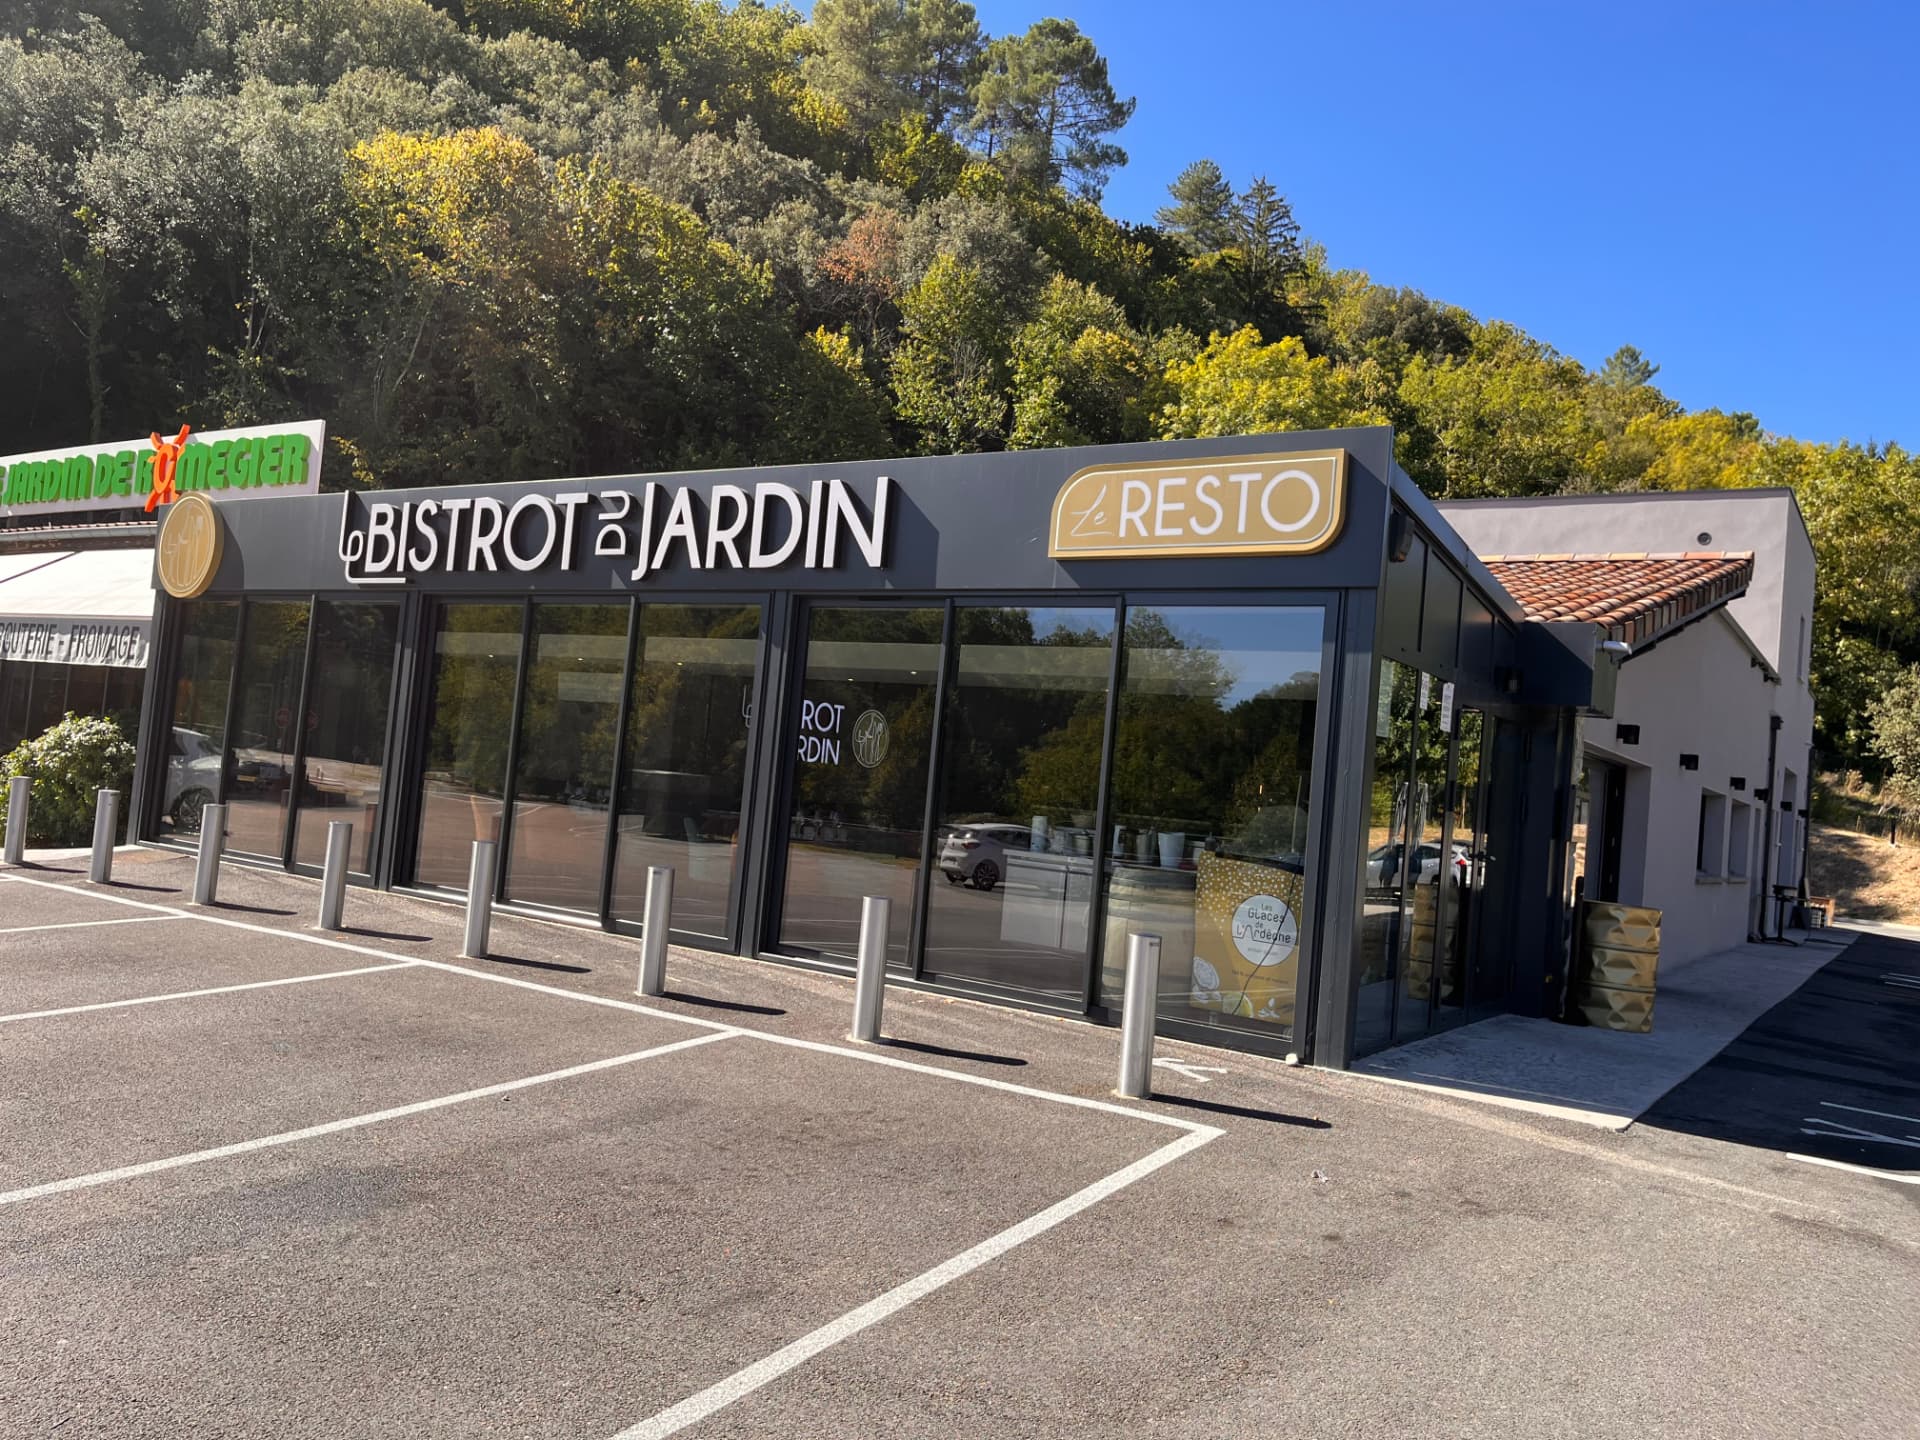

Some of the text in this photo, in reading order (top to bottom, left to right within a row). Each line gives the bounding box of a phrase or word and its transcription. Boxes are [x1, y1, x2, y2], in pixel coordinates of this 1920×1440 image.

[3, 454, 95, 507] JARDIN
[92, 450, 137, 498] DE
[1071, 469, 1321, 538] Le RESTO
[364, 493, 589, 573] BISTROT
[595, 490, 630, 555] DU
[631, 476, 889, 582] JARDIN
[69, 624, 140, 660] FROMAGE
[797, 735, 840, 765] RDIN
